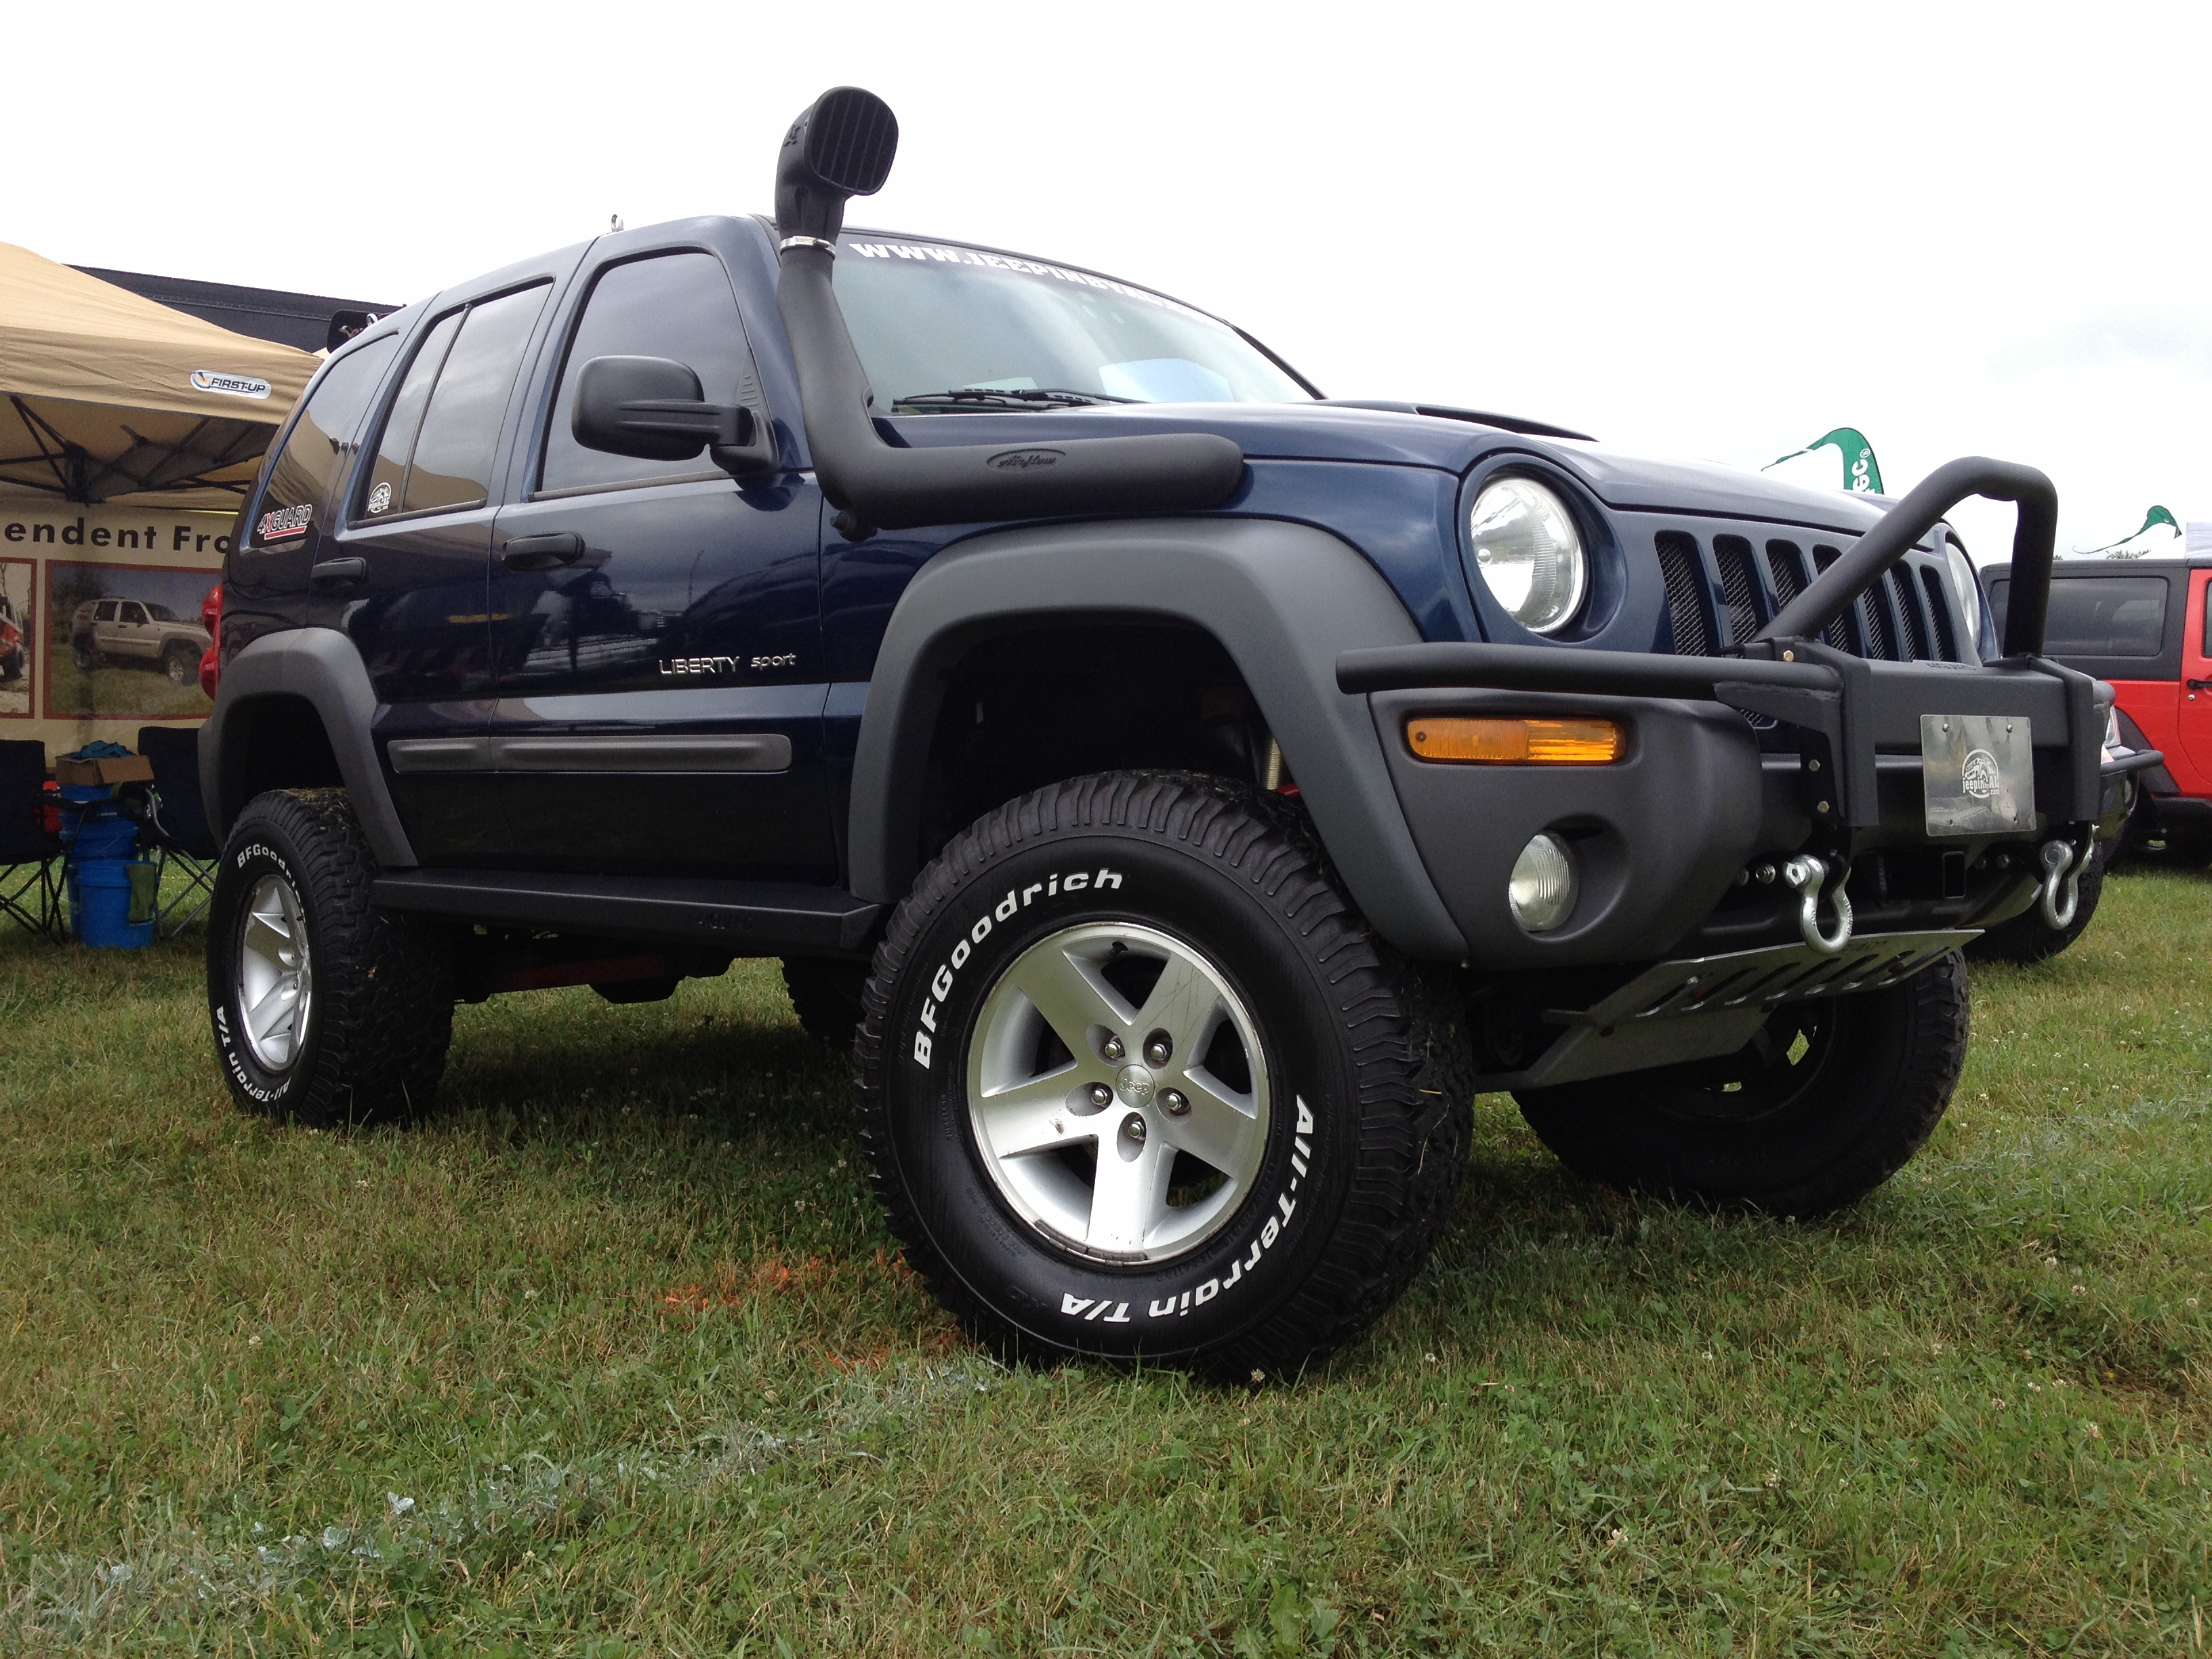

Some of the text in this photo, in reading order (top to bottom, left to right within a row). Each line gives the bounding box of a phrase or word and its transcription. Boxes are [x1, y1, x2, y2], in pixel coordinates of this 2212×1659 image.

[4, 516, 157, 549] endent
[257, 504, 312, 534] 4XGUARD
[659, 653, 796, 675] LIBERTY sport
[914, 867, 1124, 1070] BFGoodrich
[216, 1005, 291, 1102] All-Terrain T/A
[1119, 1078, 1150, 1095] Jeep
[1148, 1094, 1315, 1318] All-Terrain
[1061, 1292, 1131, 1323] T/A
